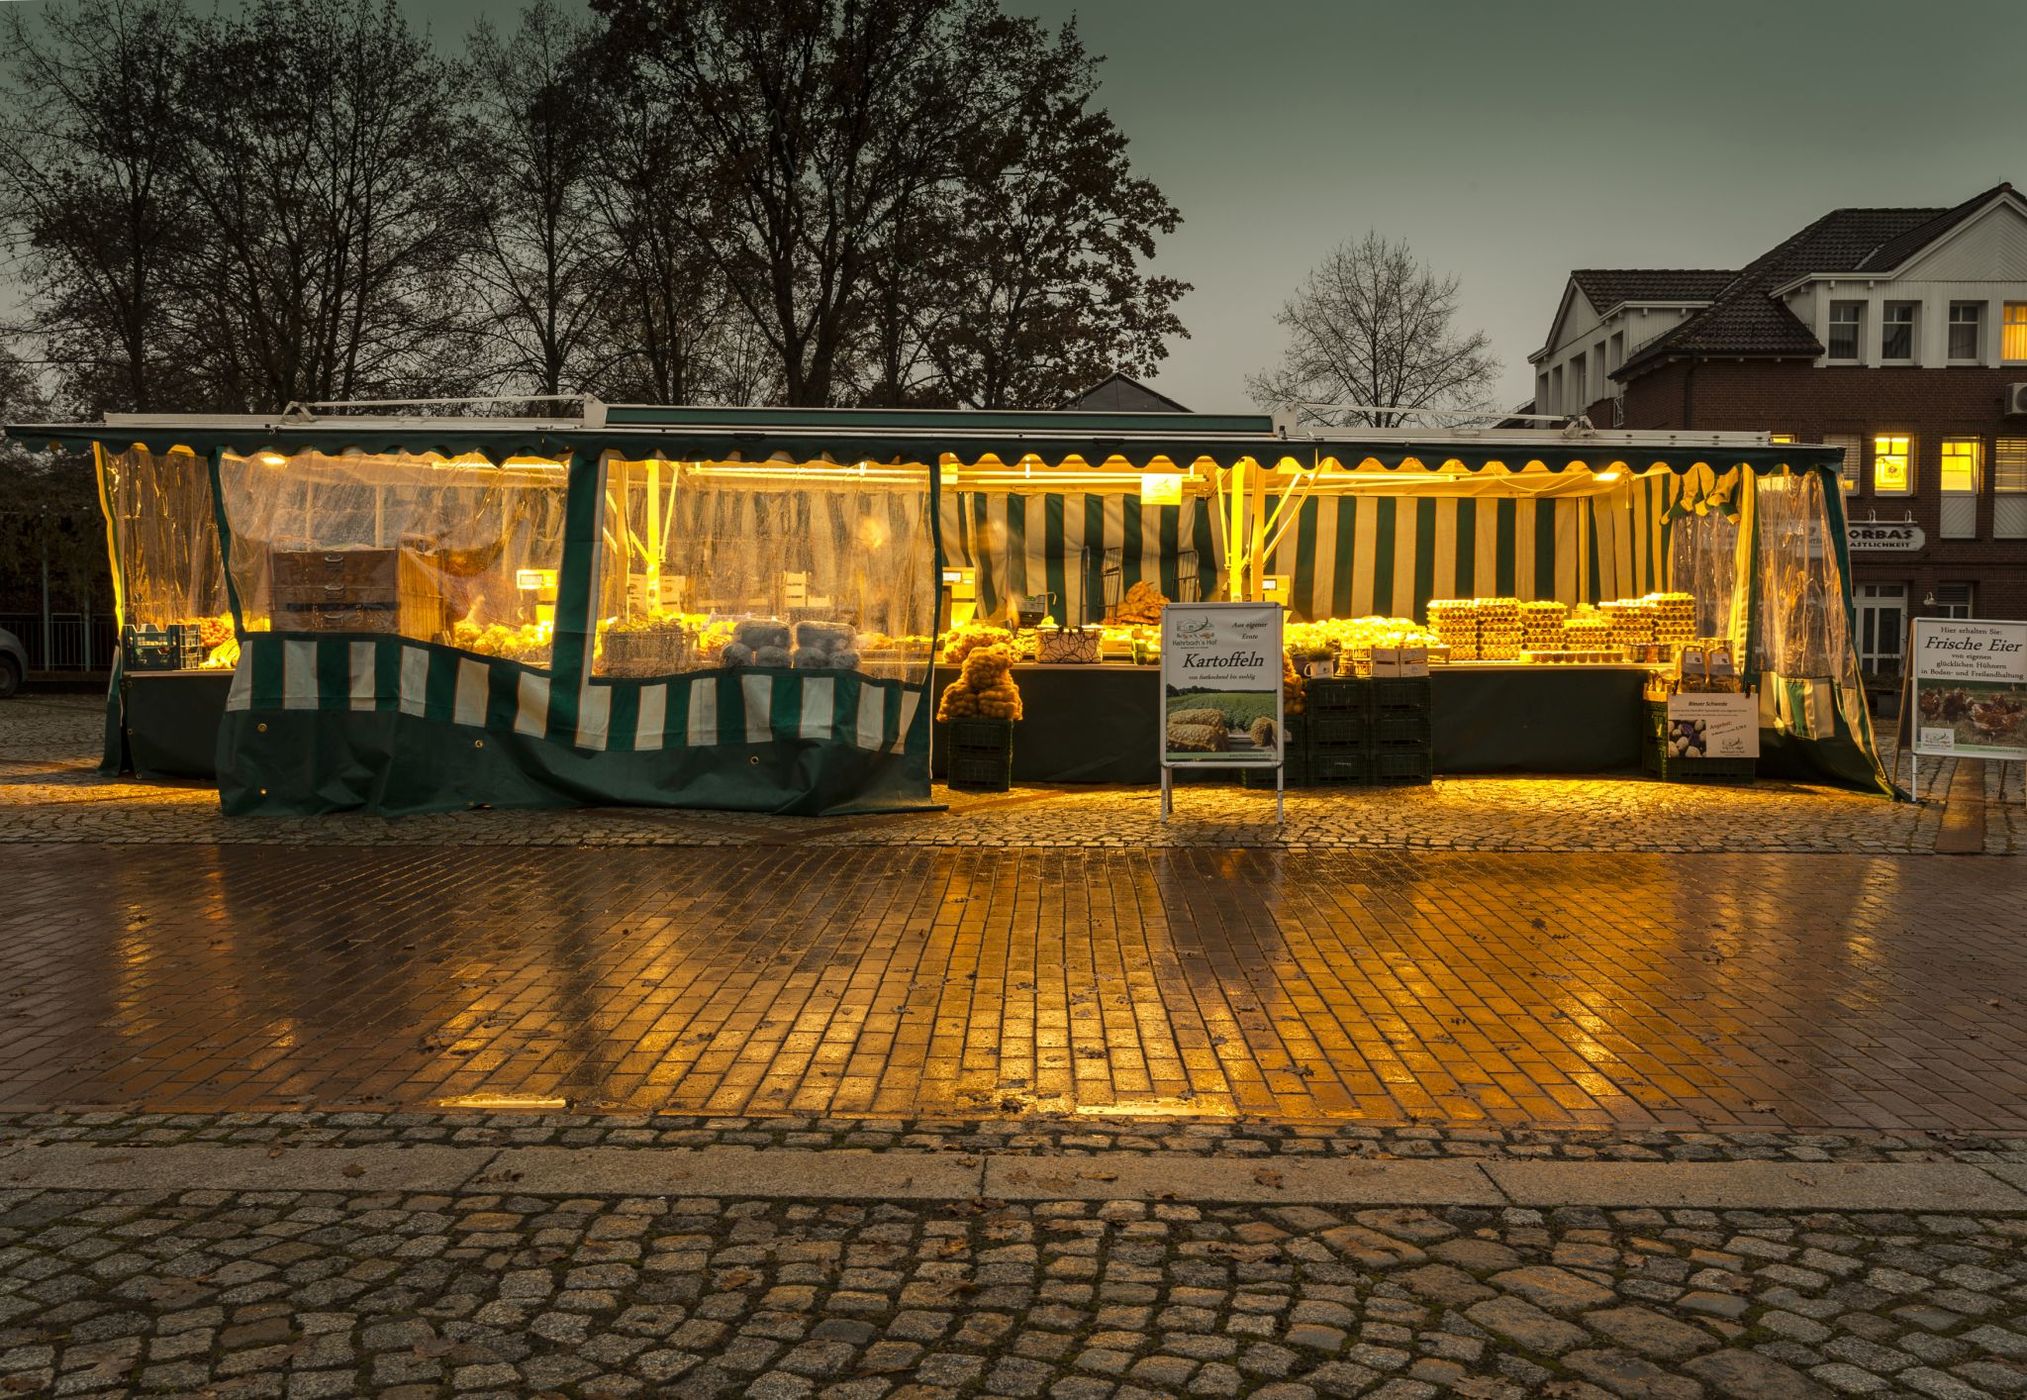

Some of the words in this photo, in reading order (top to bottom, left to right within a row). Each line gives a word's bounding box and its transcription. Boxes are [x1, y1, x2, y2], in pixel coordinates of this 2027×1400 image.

[1848, 529, 1914, 539] ORBAS
[1940, 626, 1957, 634] Hier
[1958, 627, 1987, 635] erhalten
[1924, 636, 1983, 651] Frische
[1988, 638, 2023, 653] Eier
[1182, 651, 1265, 668] Kartoffeln
[1966, 653, 1992, 661] eigenen
[1936, 660, 1974, 668] glücklichen
[1976, 661, 2007, 669] Hühnern
[1930, 668, 1954, 676] Boden-
[1971, 670, 2025, 680] Freilandhaltung
